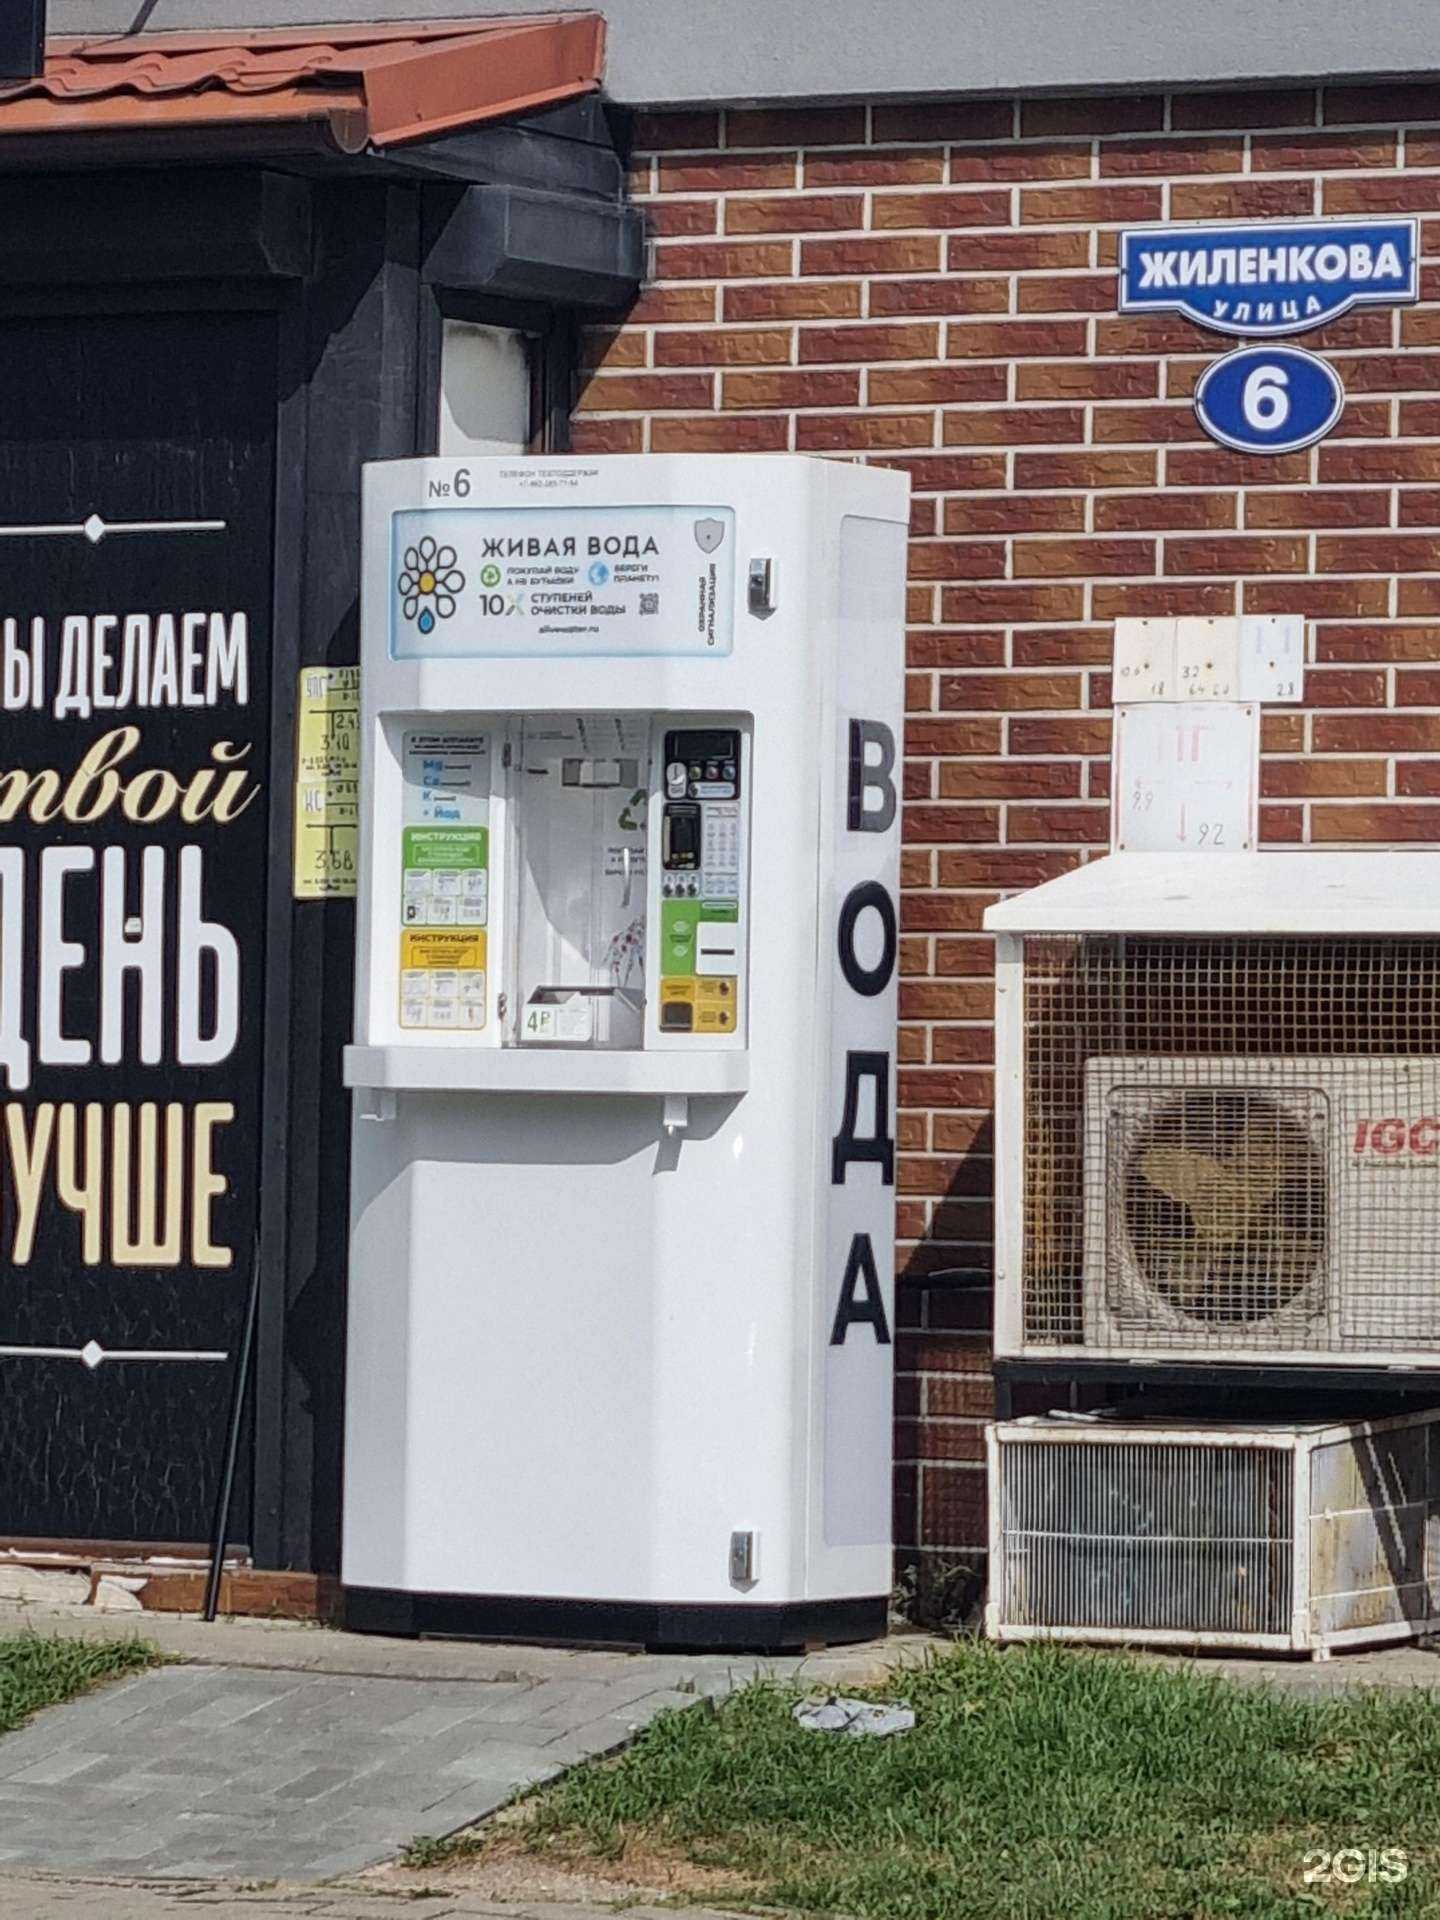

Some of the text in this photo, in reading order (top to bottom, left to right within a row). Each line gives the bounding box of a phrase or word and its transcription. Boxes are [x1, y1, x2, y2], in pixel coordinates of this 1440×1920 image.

[1138, 243, 1403, 288] ЖИЛЕНКОВА
[1213, 295, 1322, 322] УЛИЦА
[1243, 365, 1290, 431] 6
[481, 535, 660, 558] ЖИВАЯ ВОДА
[506, 566, 553, 576] ПОКУПАЙ
[530, 590, 593, 604] СТУПЕНЕЙ
[530, 604, 627, 616] ОЧИСТКИ ВОДЫ
[2, 612, 249, 720] Ы ДЕЛАЕМ
[828, 717, 899, 1347] ВОДА
[5, 1102, 235, 1268] УЧШЕ
